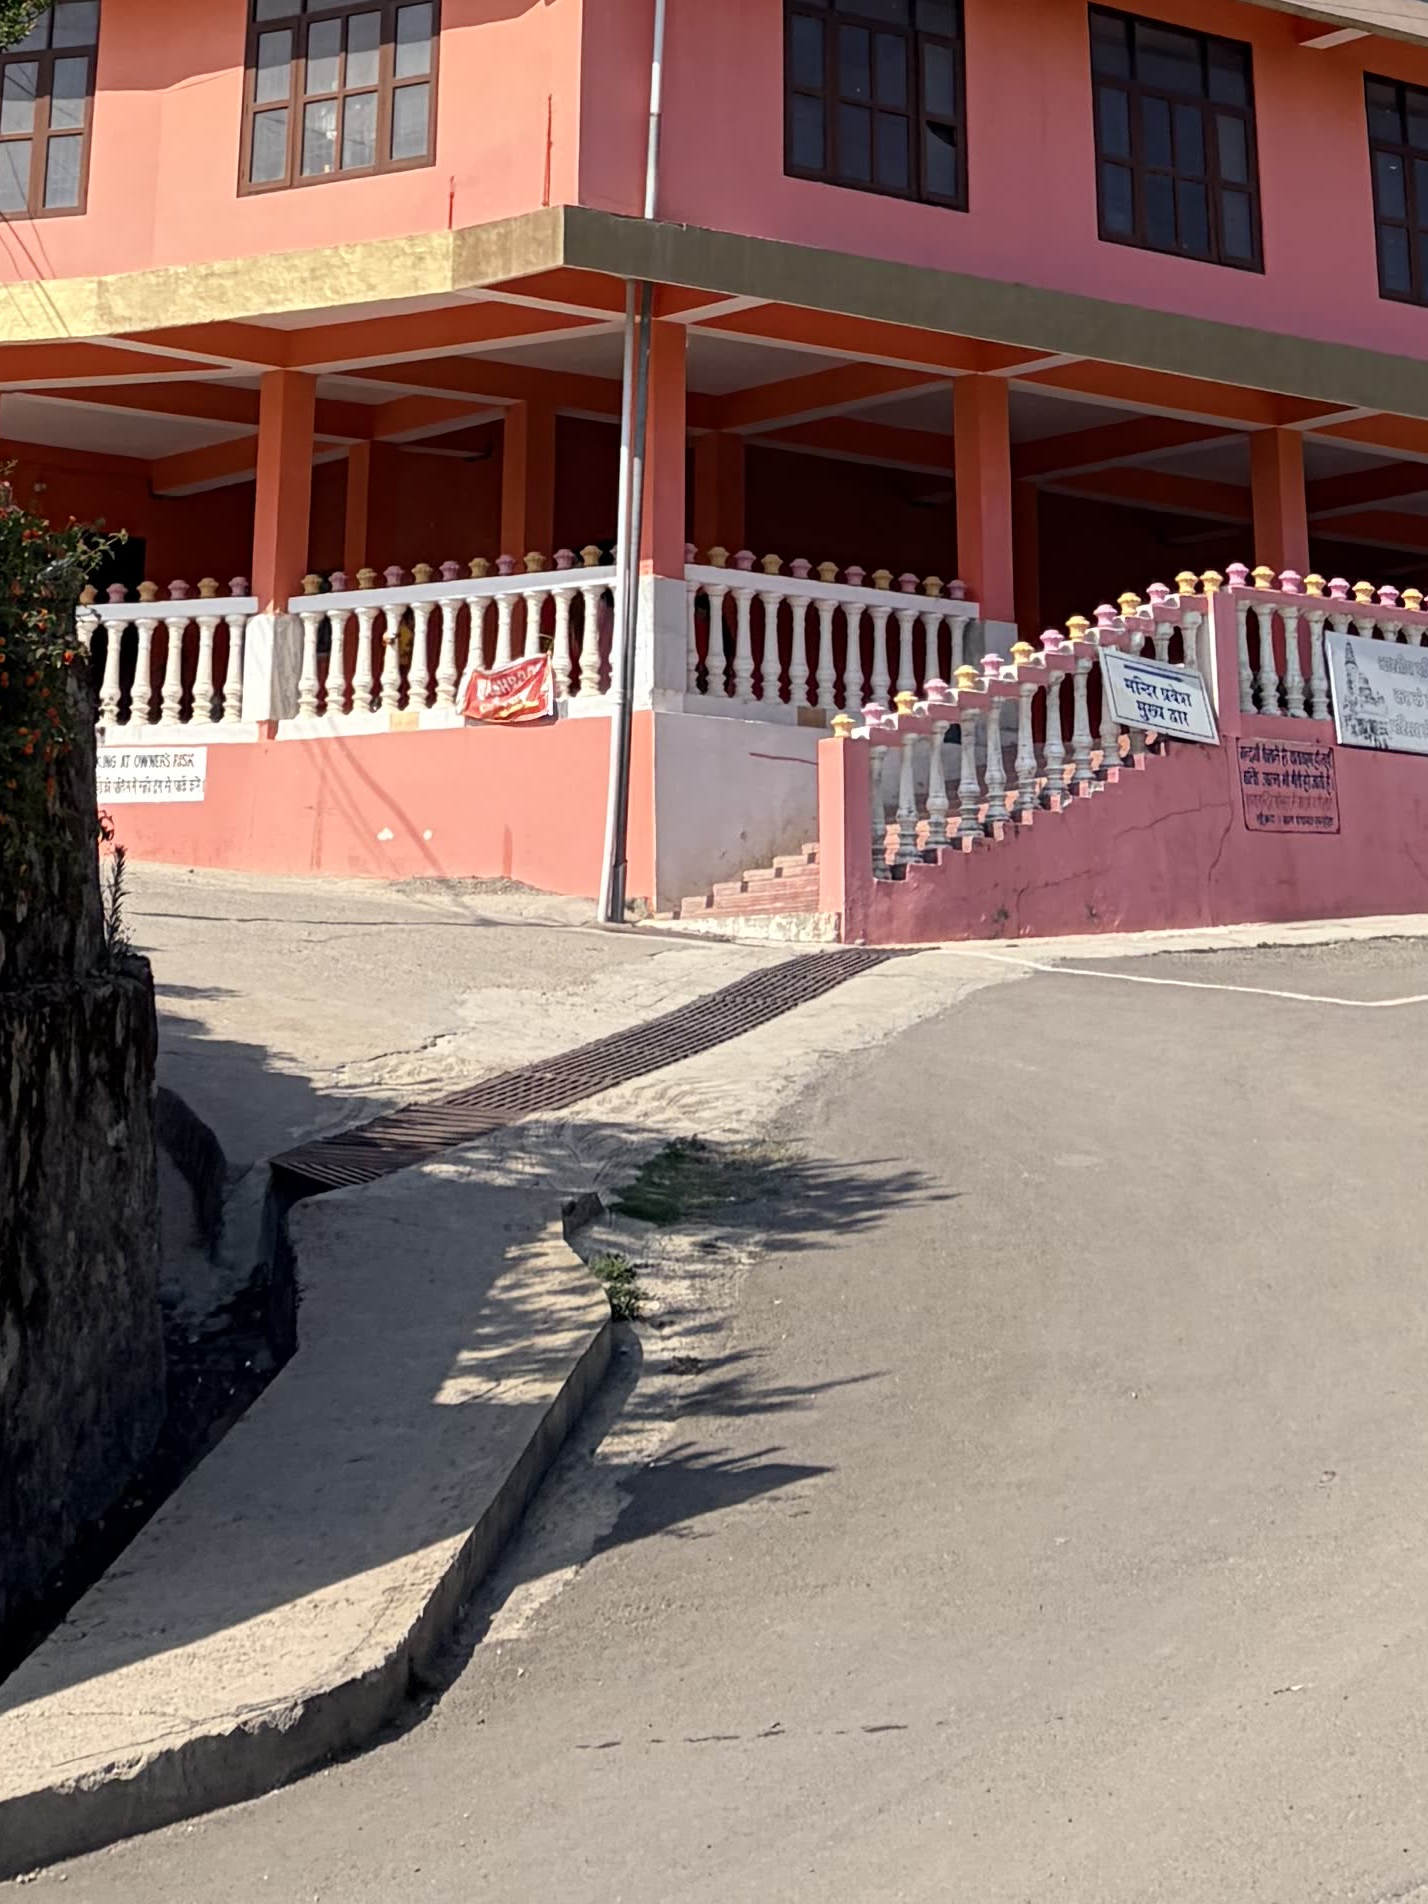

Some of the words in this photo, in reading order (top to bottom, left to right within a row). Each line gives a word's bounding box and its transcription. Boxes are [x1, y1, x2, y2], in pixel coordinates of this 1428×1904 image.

[1124, 676, 1160, 701] मन्दिर
[1160, 684, 1193, 708] प्रवेश
[1136, 700, 1166, 722] मुख्य
[1167, 708, 1190, 728] द्वार
[120, 754, 131, 768] AT
